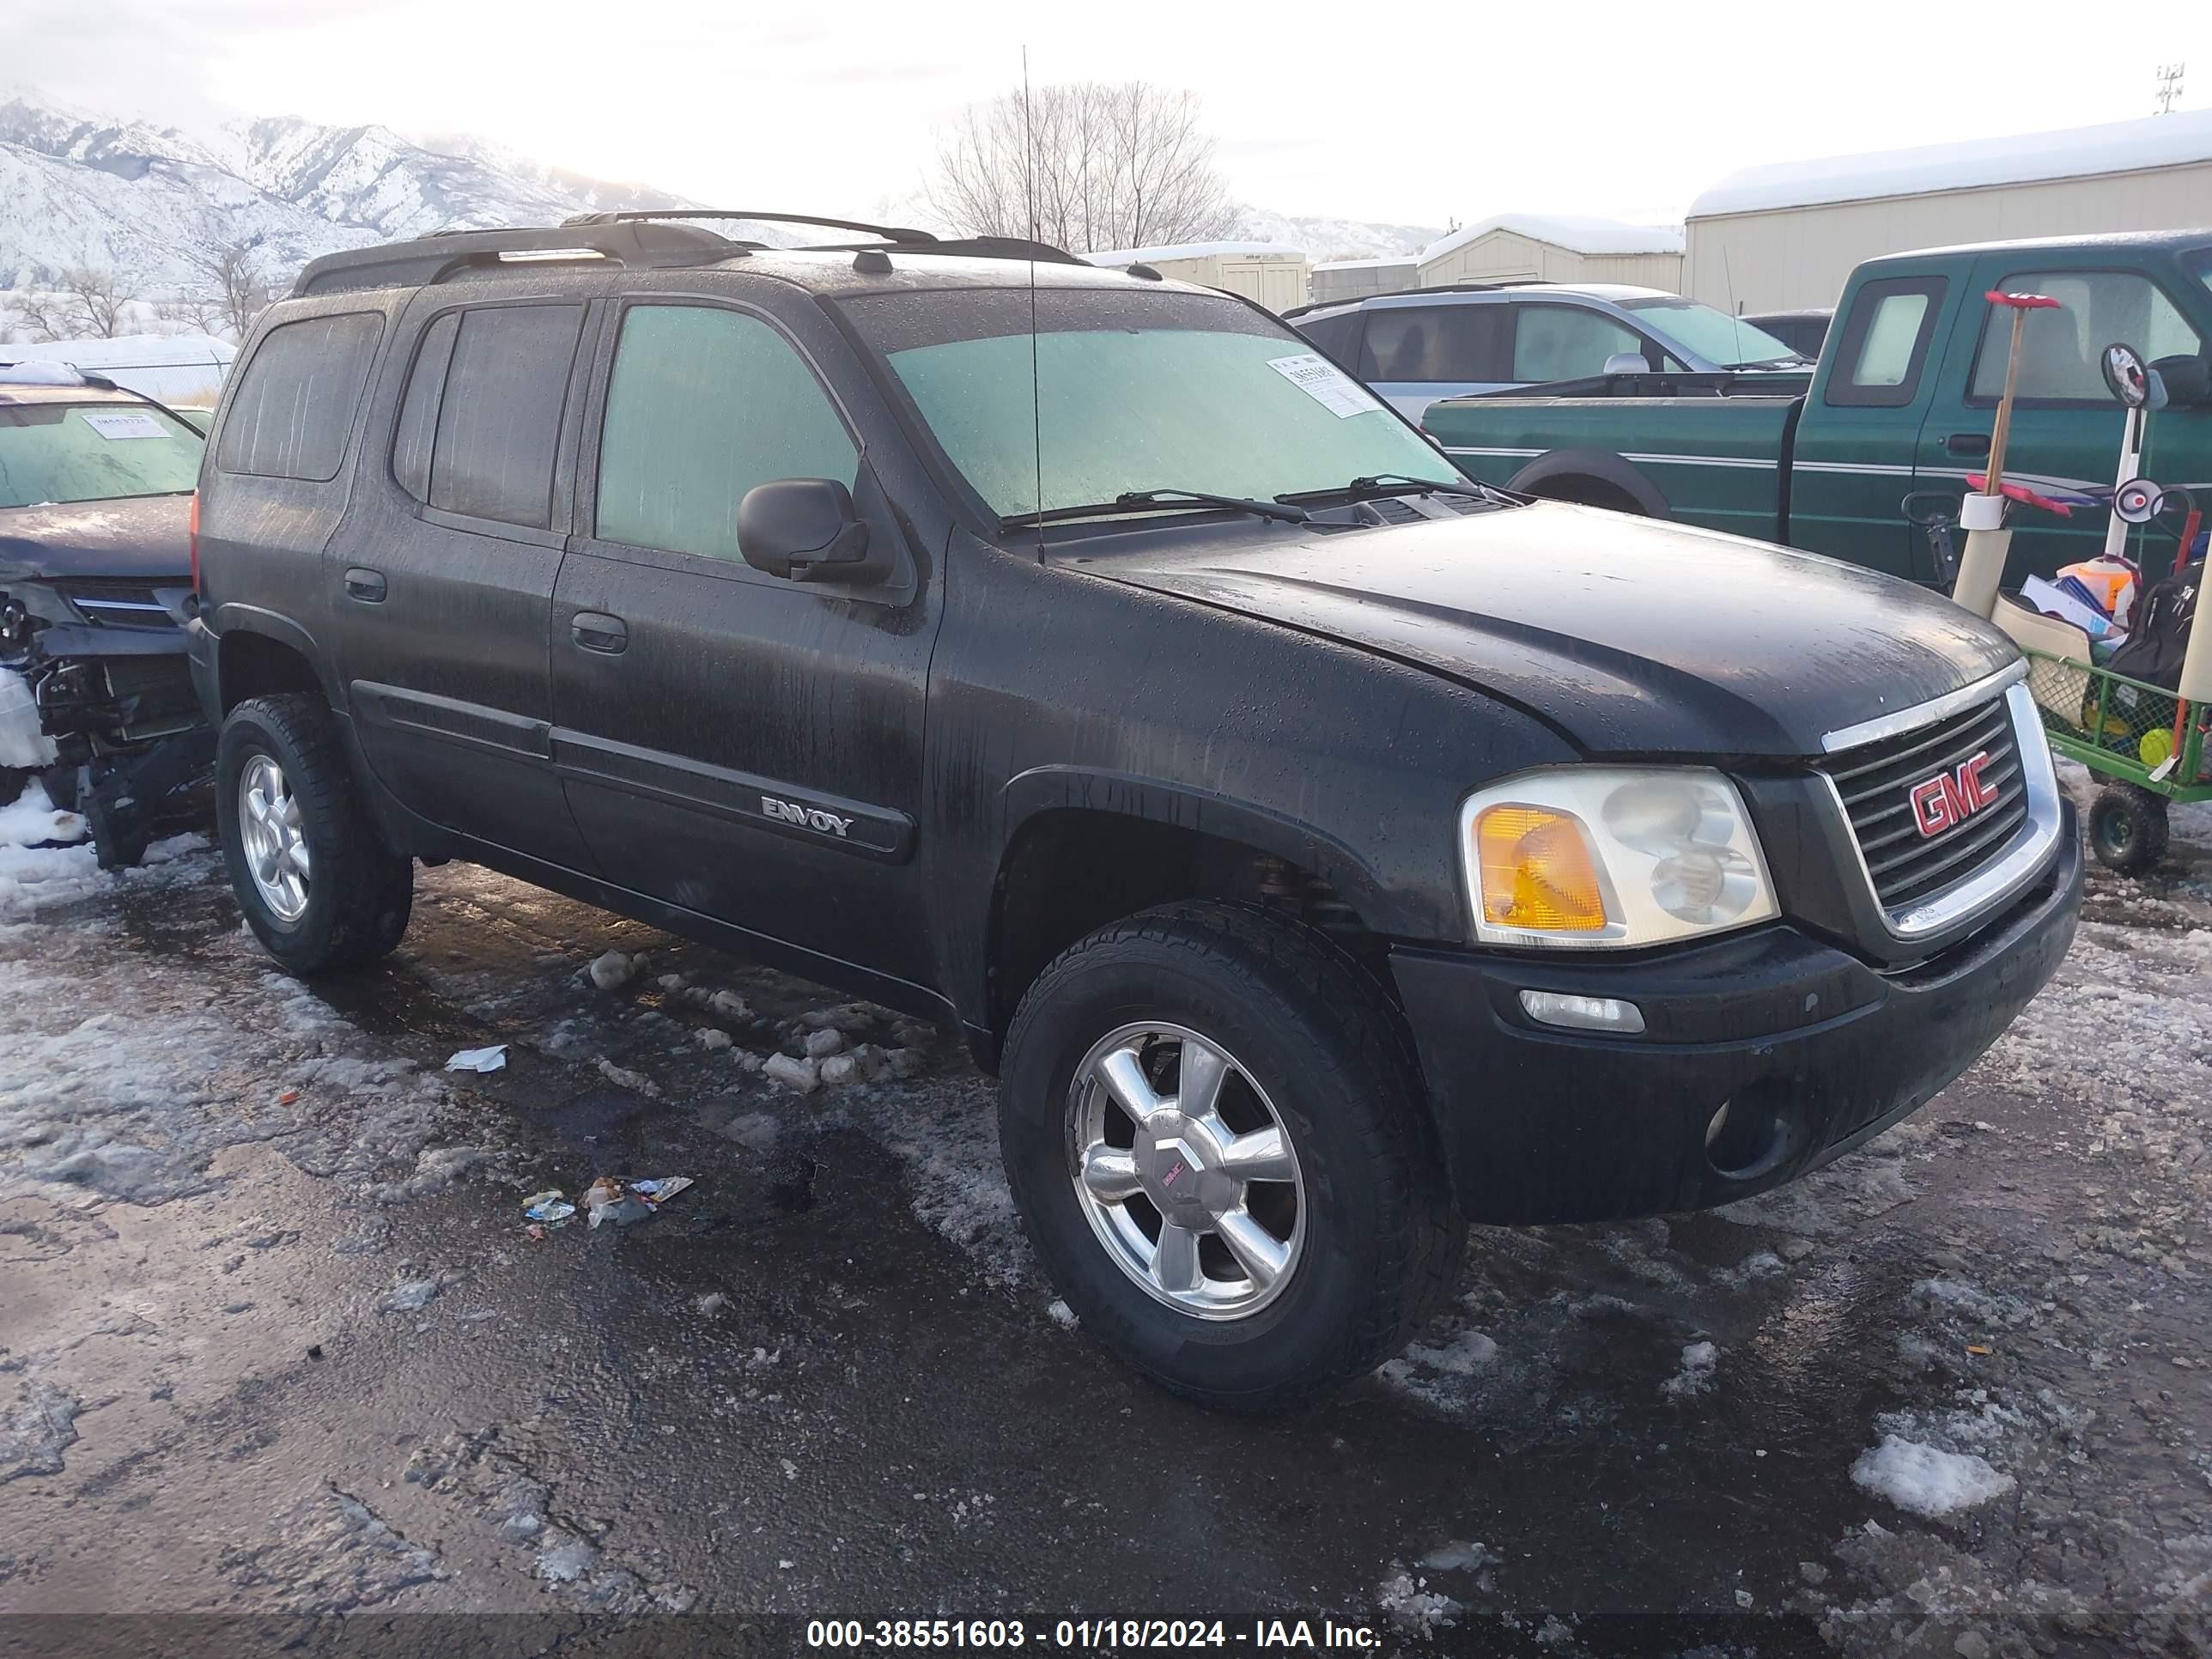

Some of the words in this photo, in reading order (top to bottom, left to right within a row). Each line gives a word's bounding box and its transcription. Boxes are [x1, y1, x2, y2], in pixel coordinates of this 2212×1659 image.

[1909, 750, 1999, 839] GMC
[761, 796, 854, 837] ENVOY
[1162, 1161, 1185, 1187] GMC
